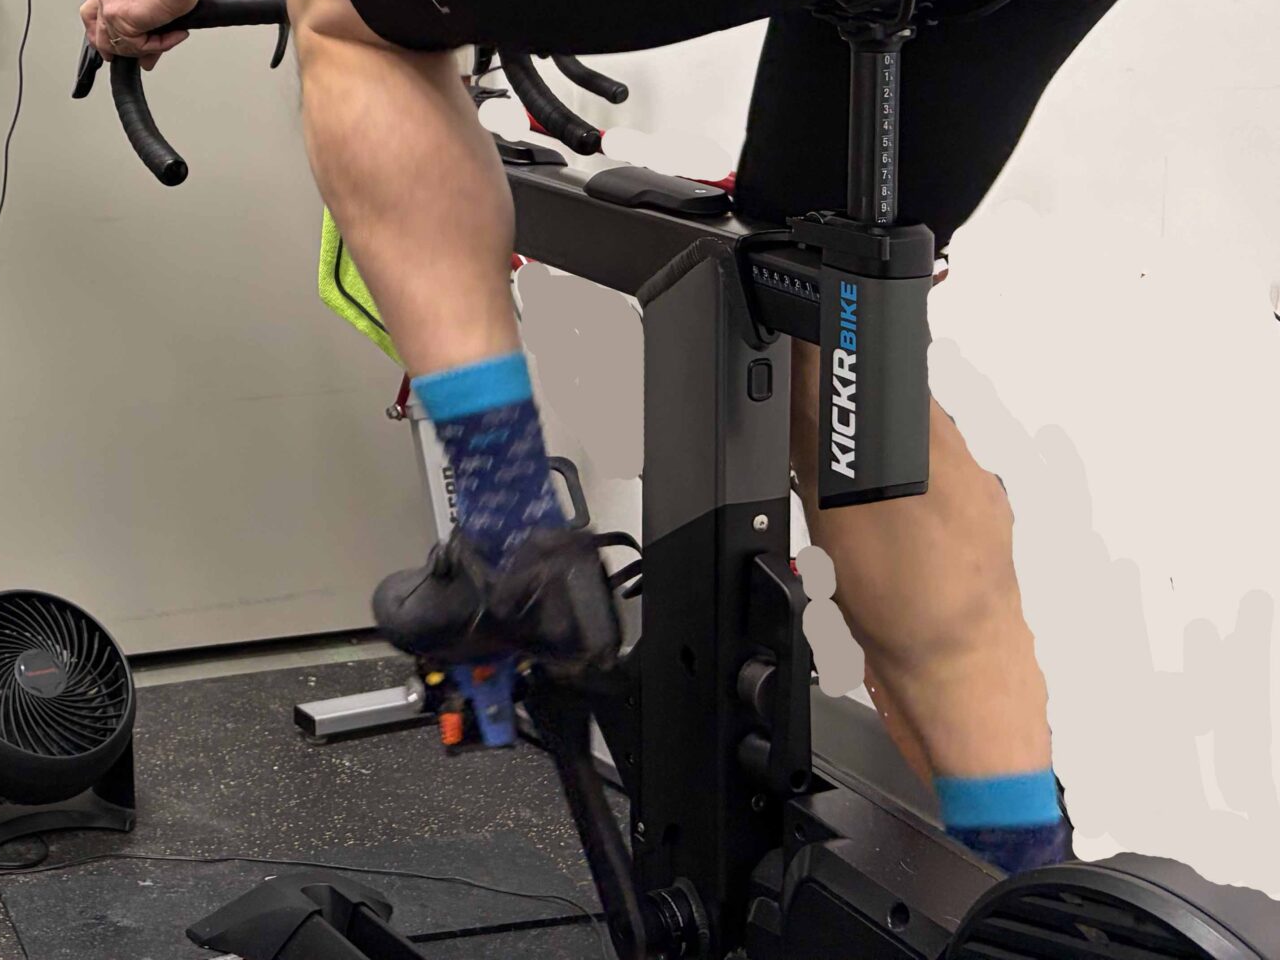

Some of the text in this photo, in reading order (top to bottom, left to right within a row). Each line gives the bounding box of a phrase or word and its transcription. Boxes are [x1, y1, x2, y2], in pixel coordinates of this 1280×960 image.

[884, 55, 890, 65] 0
[884, 72, 889, 81] 1
[883, 88, 890, 97] 2
[883, 105, 889, 114] 3
[882, 121, 889, 130] 4
[882, 137, 888, 147] 5
[882, 154, 888, 163] 6
[881, 170, 887, 179] 7
[881, 186, 887, 196] 8
[881, 203, 887, 212] 9
